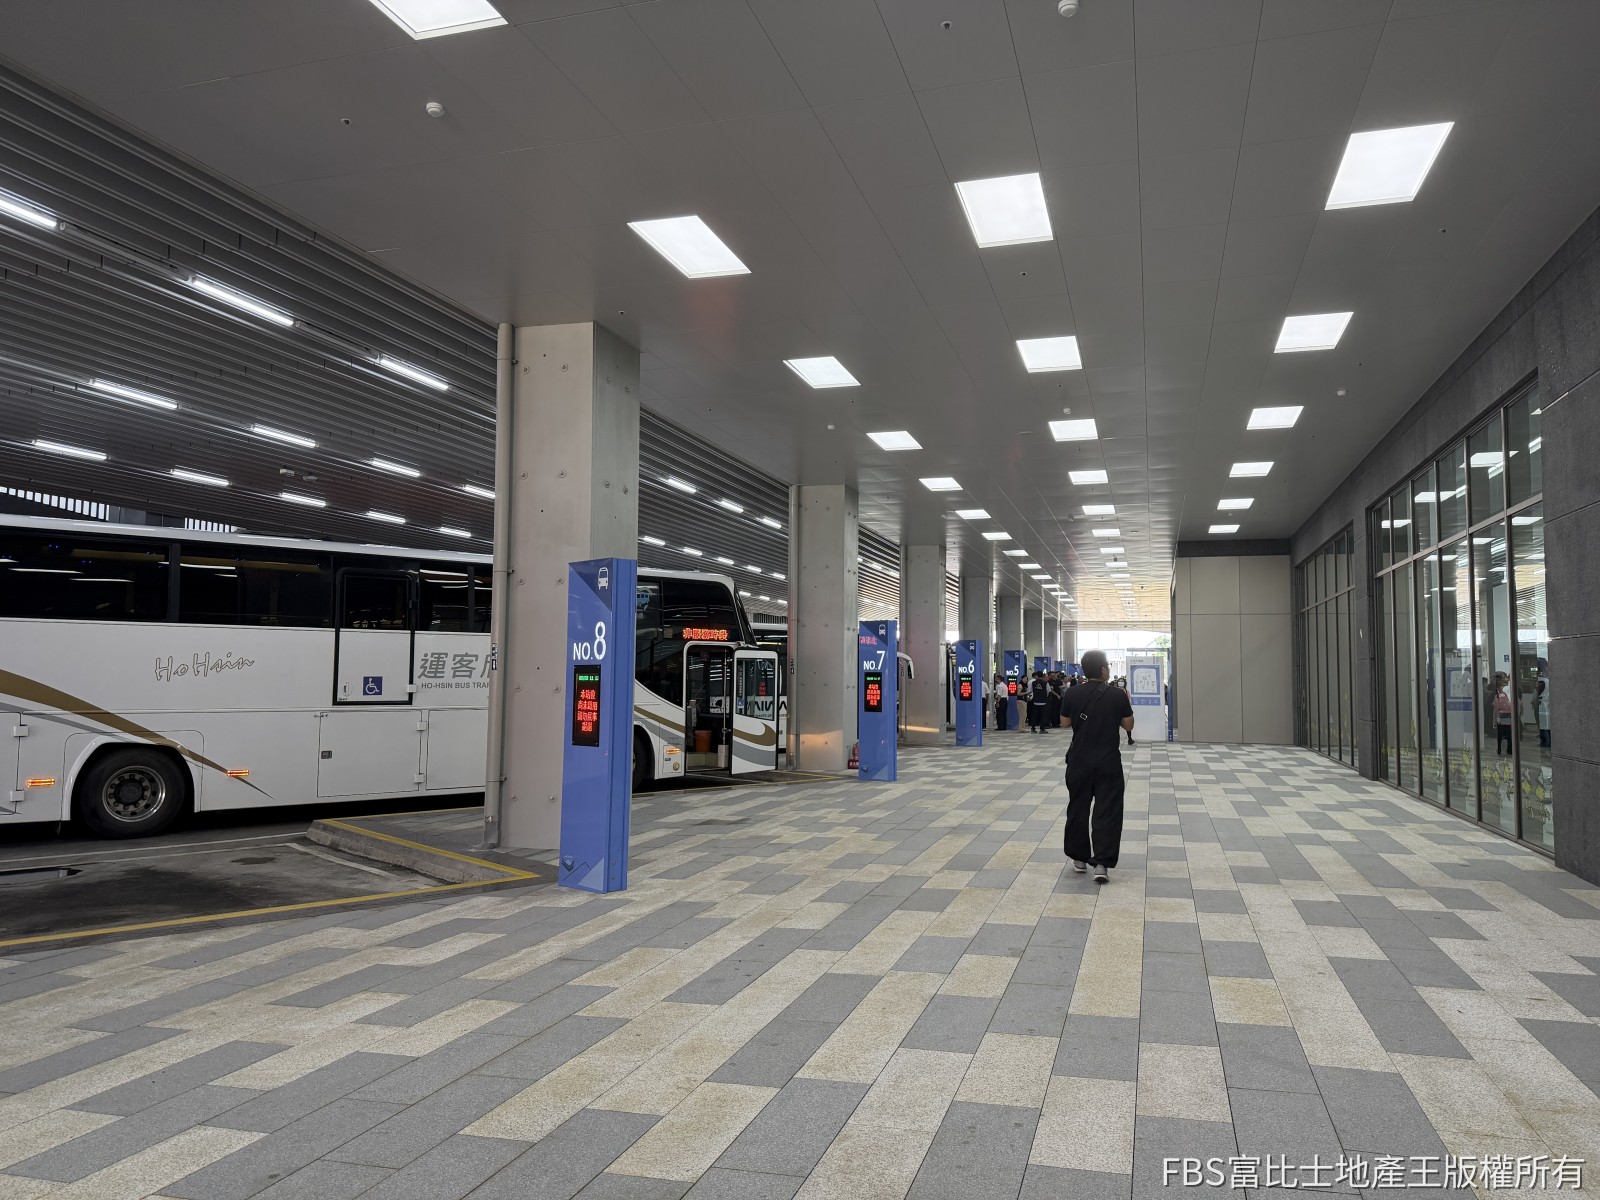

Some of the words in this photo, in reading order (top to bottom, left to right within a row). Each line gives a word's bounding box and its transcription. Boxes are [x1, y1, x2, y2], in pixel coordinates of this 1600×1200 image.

[573, 621, 607, 660] NO.8
[863, 650, 886, 671] NO.7
[958, 660, 975, 674] NO.6
[1006, 665, 1019, 676] NO.5
